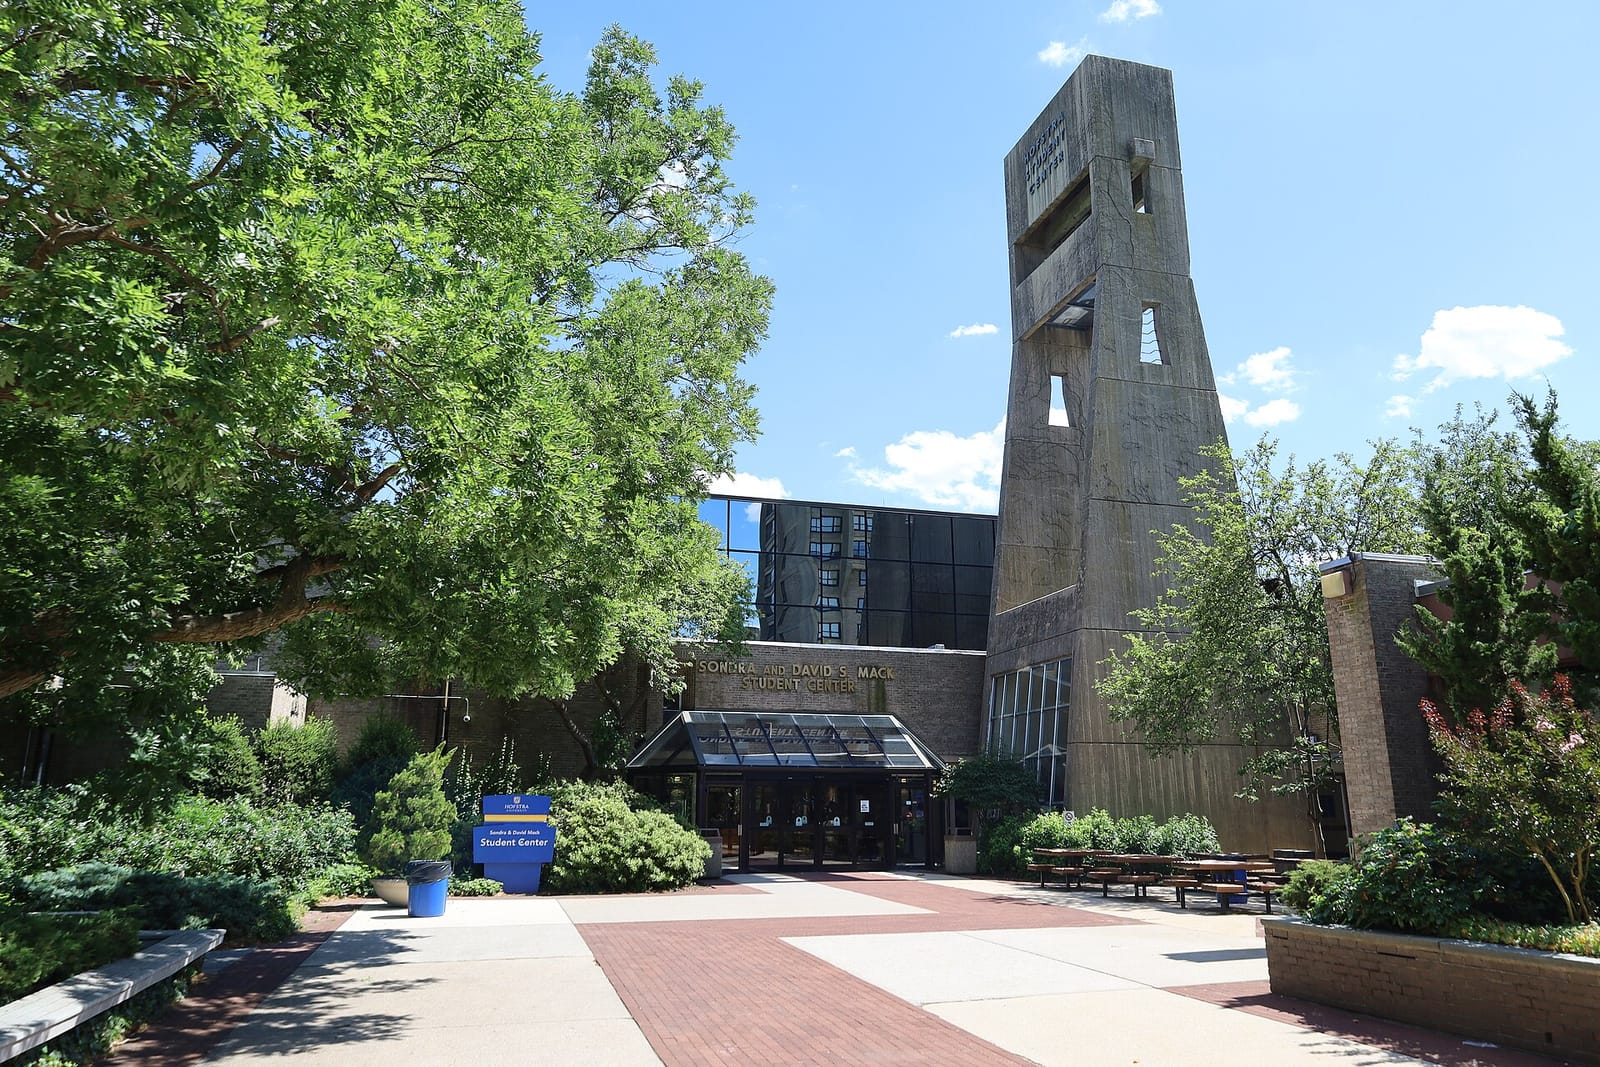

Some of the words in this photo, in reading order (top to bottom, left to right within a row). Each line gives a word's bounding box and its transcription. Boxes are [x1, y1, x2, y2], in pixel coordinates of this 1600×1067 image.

[1024, 111, 1065, 165] HOFSTRA
[1025, 127, 1065, 182] STUDENT
[1029, 150, 1064, 195] CENTER
[699, 660, 756, 674] SONDRA
[763, 665, 786, 676] AND
[792, 664, 832, 677] DAVID
[858, 666, 895, 679] MACK
[742, 676, 801, 690] STUDENT
[806, 678, 855, 692] CENTER
[480, 838, 516, 847] Student
[518, 838, 548, 847] Center
